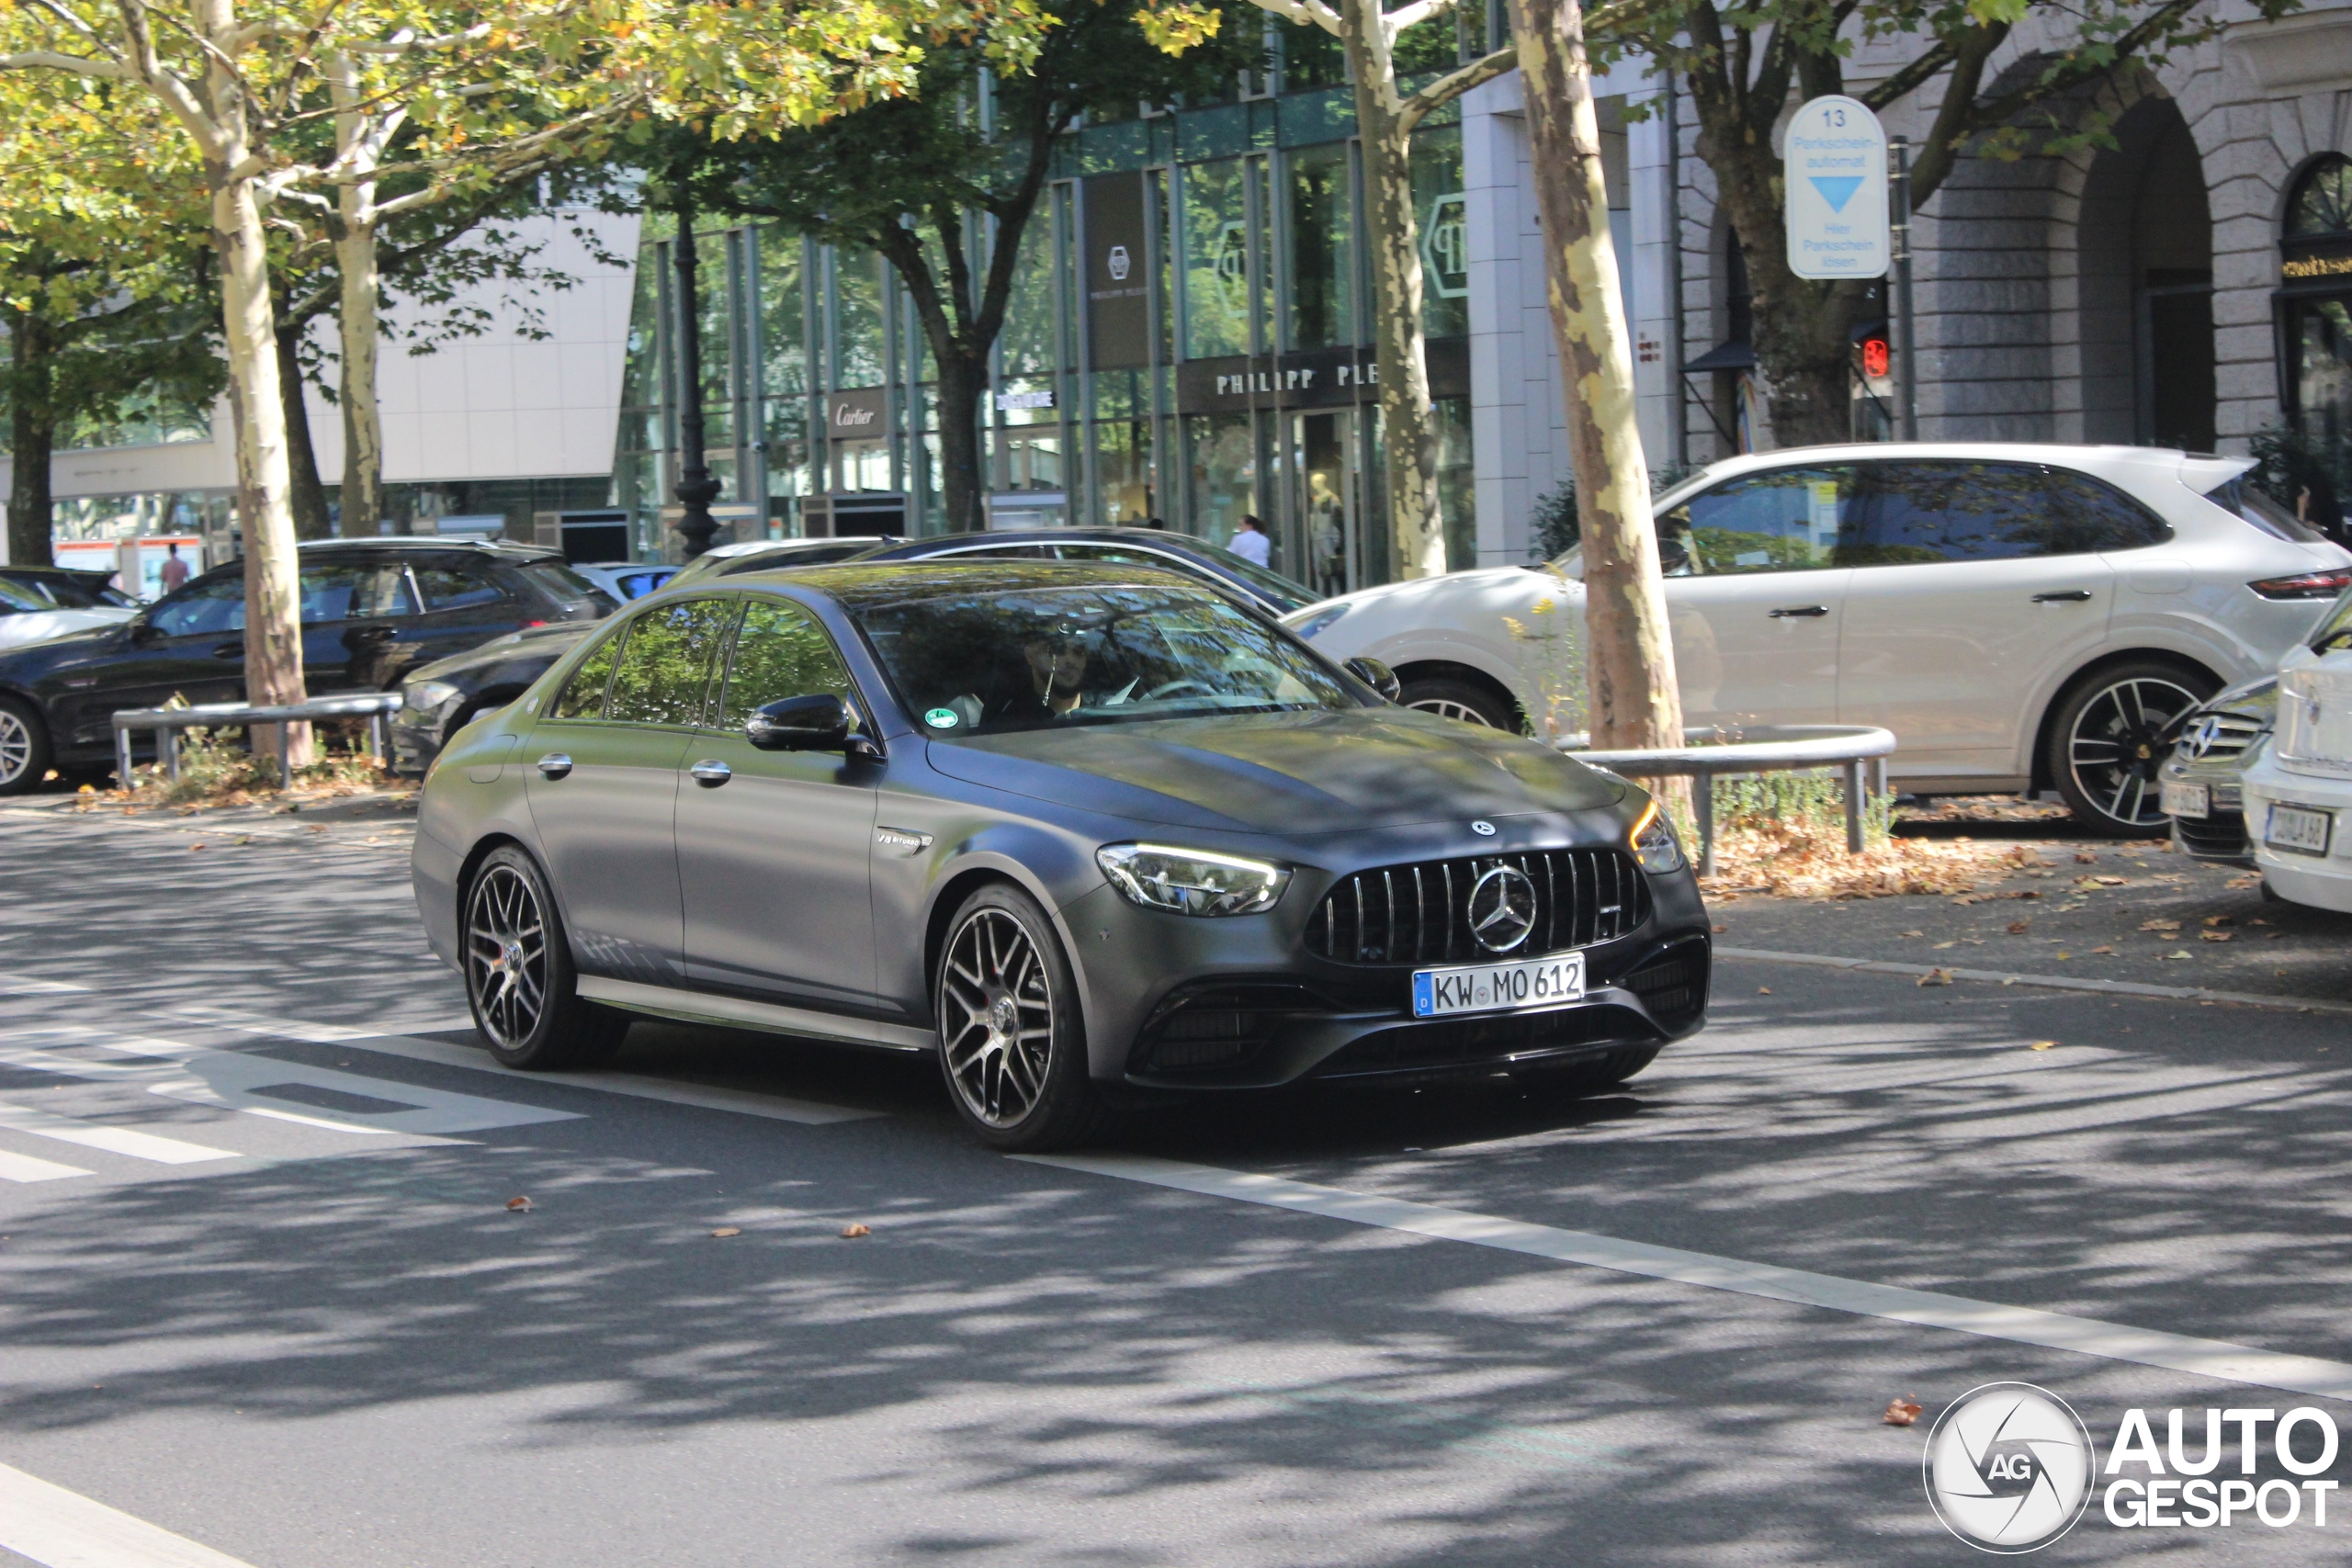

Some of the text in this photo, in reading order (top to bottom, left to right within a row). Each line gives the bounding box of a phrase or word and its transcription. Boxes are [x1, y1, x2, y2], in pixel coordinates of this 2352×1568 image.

[1822, 109, 1846, 127] 13
[1794, 136, 1878, 150] Parkschein-
[1806, 155, 1865, 167] automat
[1825, 223, 1850, 234] Hier
[1803, 239, 1874, 252] Parkschein
[1822, 255, 1857, 267] lösen
[1217, 368, 1312, 395] PHILIPP
[836, 403, 874, 427] Cartier
[878, 834, 920, 846] V8 BITURBO
[1420, 964, 1579, 1009] D KW MO 612
